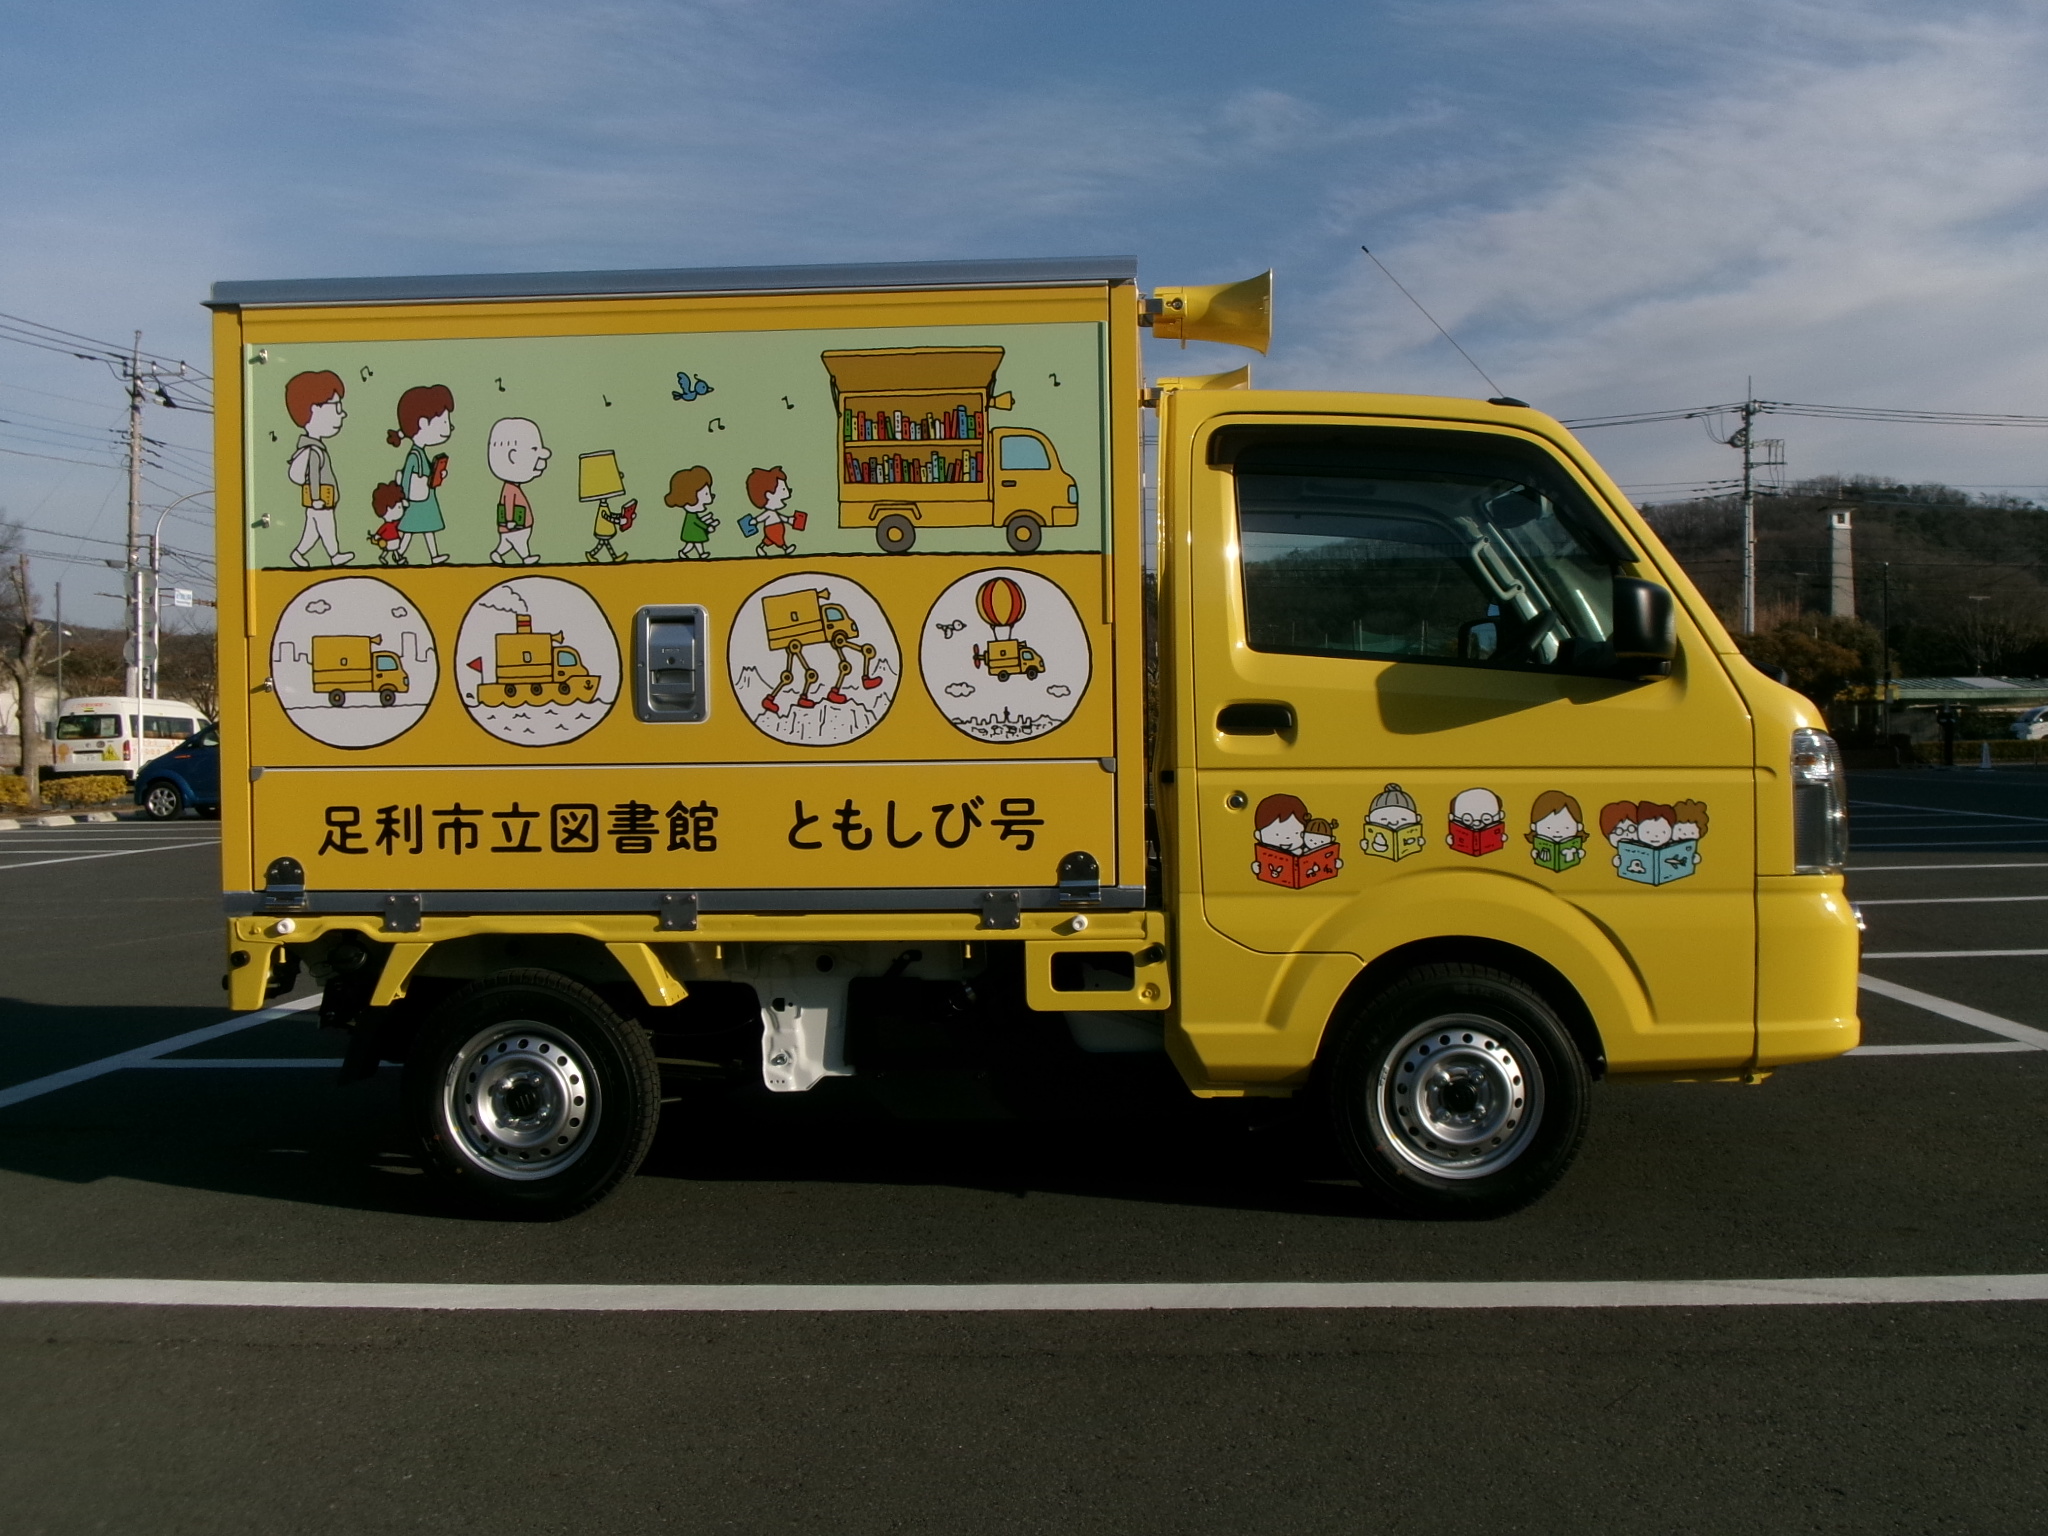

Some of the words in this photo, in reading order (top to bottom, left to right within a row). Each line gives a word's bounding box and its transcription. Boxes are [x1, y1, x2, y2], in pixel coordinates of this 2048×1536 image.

[319, 799, 719, 856] 足利市立図書館
[788, 796, 1045, 851] ともしび号
